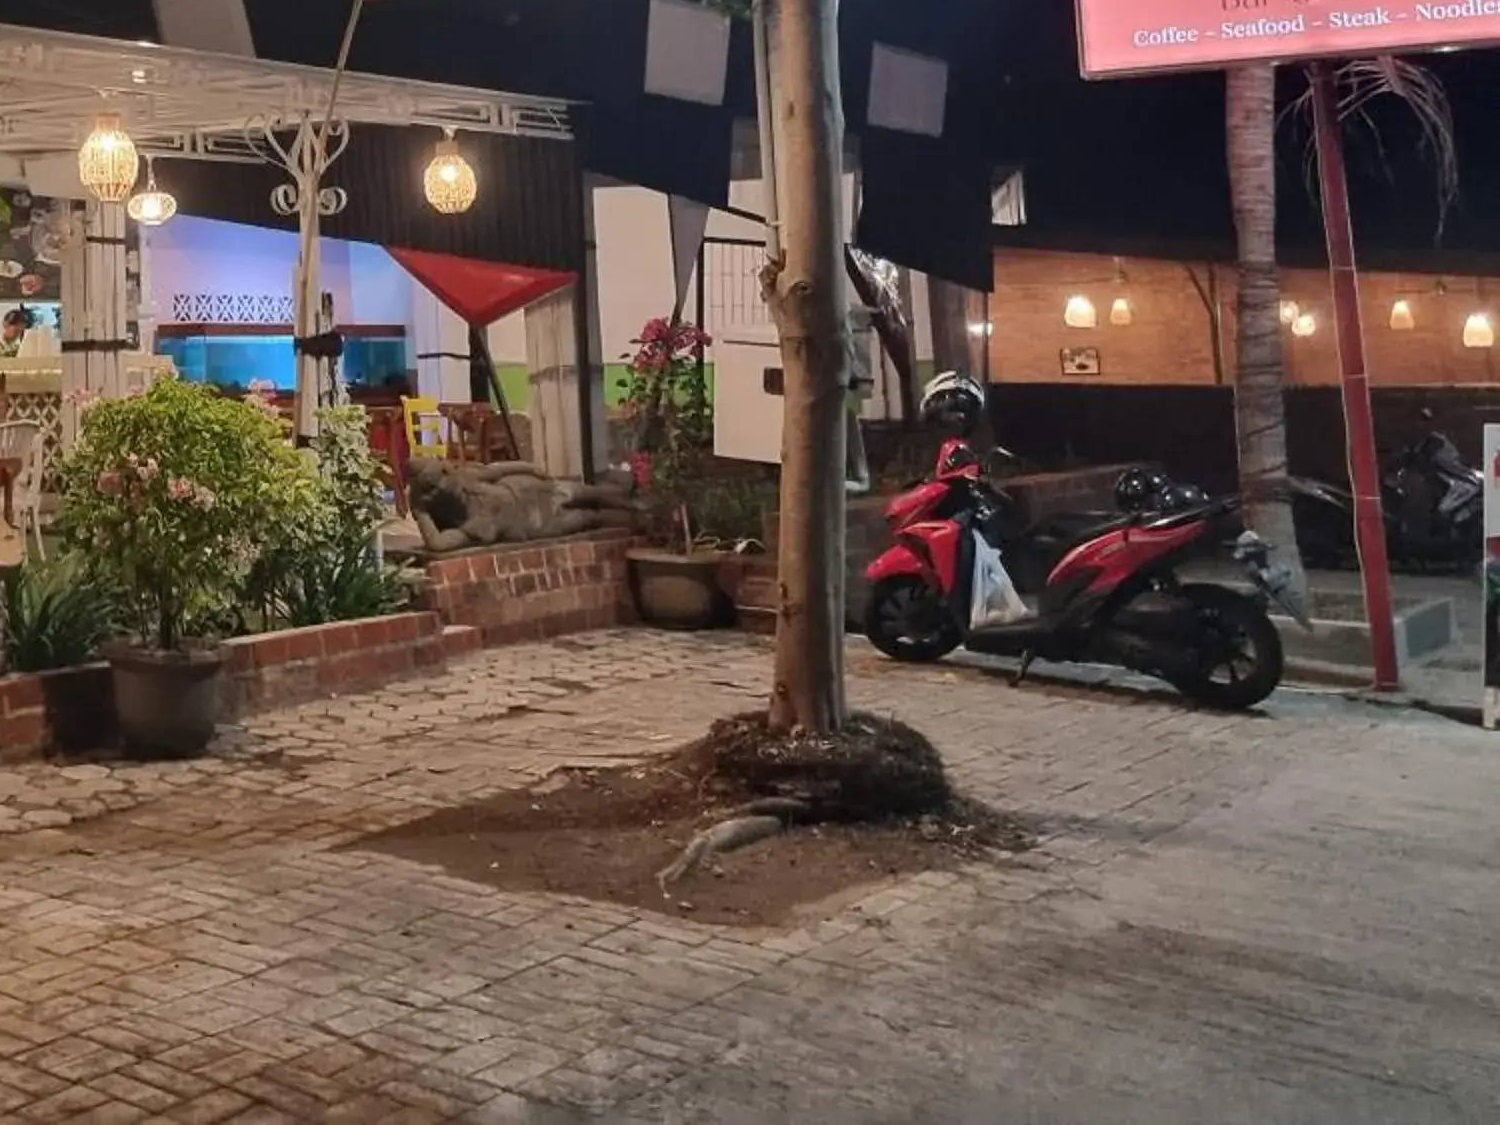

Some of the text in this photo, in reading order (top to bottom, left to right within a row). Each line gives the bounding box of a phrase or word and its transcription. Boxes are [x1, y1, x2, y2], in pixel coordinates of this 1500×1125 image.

[1132, 25, 1200, 47] Coffee
[1220, 14, 1306, 39] Seafood
[1328, 6, 1392, 29] Steak
